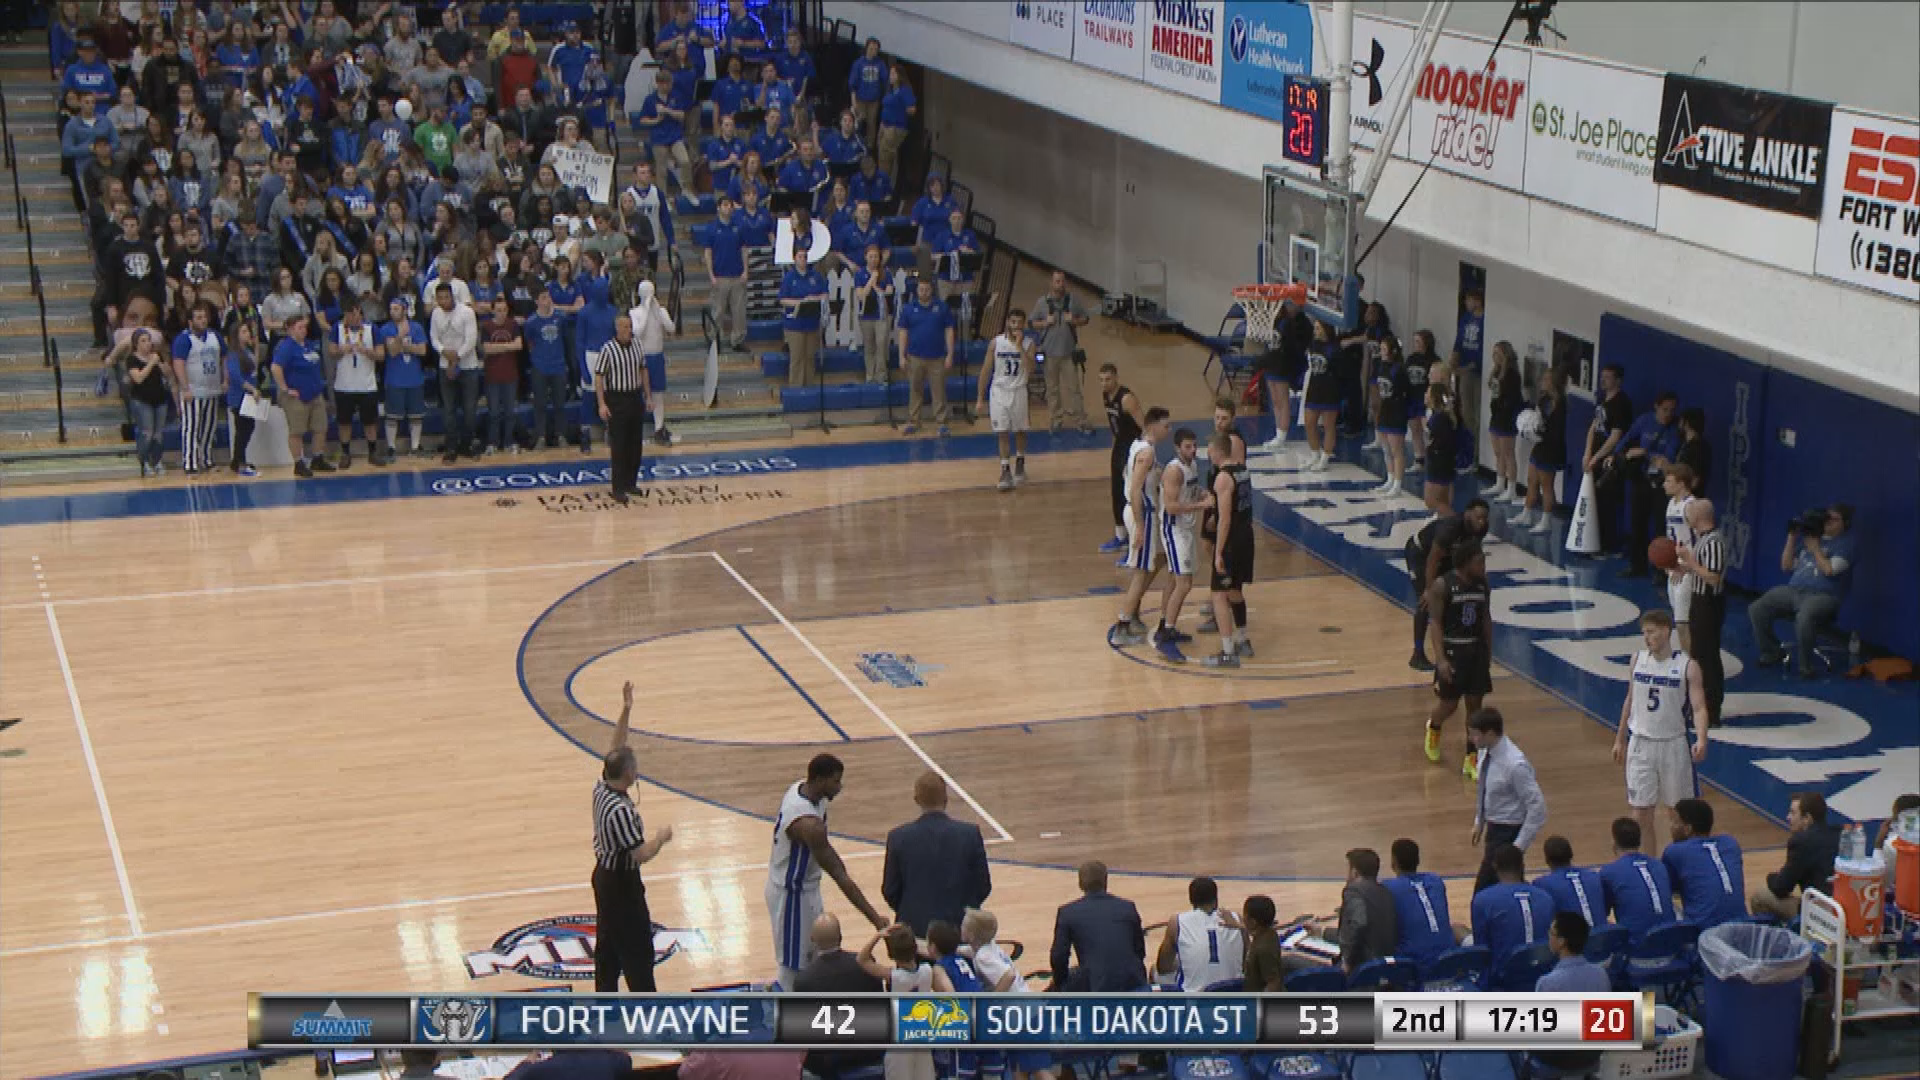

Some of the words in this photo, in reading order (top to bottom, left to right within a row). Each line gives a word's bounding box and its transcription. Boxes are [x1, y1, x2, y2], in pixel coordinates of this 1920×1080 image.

[1036, 5, 1064, 29] PLACE
[1084, 19, 1134, 49] TRAILWAYS
[1249, 19, 1288, 49] Lutheran
[1151, 23, 1214, 67] AMERICA
[1248, 48, 1273, 69] Health
[1273, 53, 1304, 74] Network
[1289, 110, 1313, 157] 20
[1431, 104, 1502, 171] ride!
[1549, 104, 1567, 140] St.
[1569, 109, 1604, 149] Joe
[1606, 118, 1658, 161] Place
[1662, 90, 1745, 171] ACTIVE
[1750, 135, 1823, 186] ANKLE
[1840, 195, 1897, 231] FORT
[1647, 688, 1660, 712] 5
[1207, 928, 1220, 965] 1
